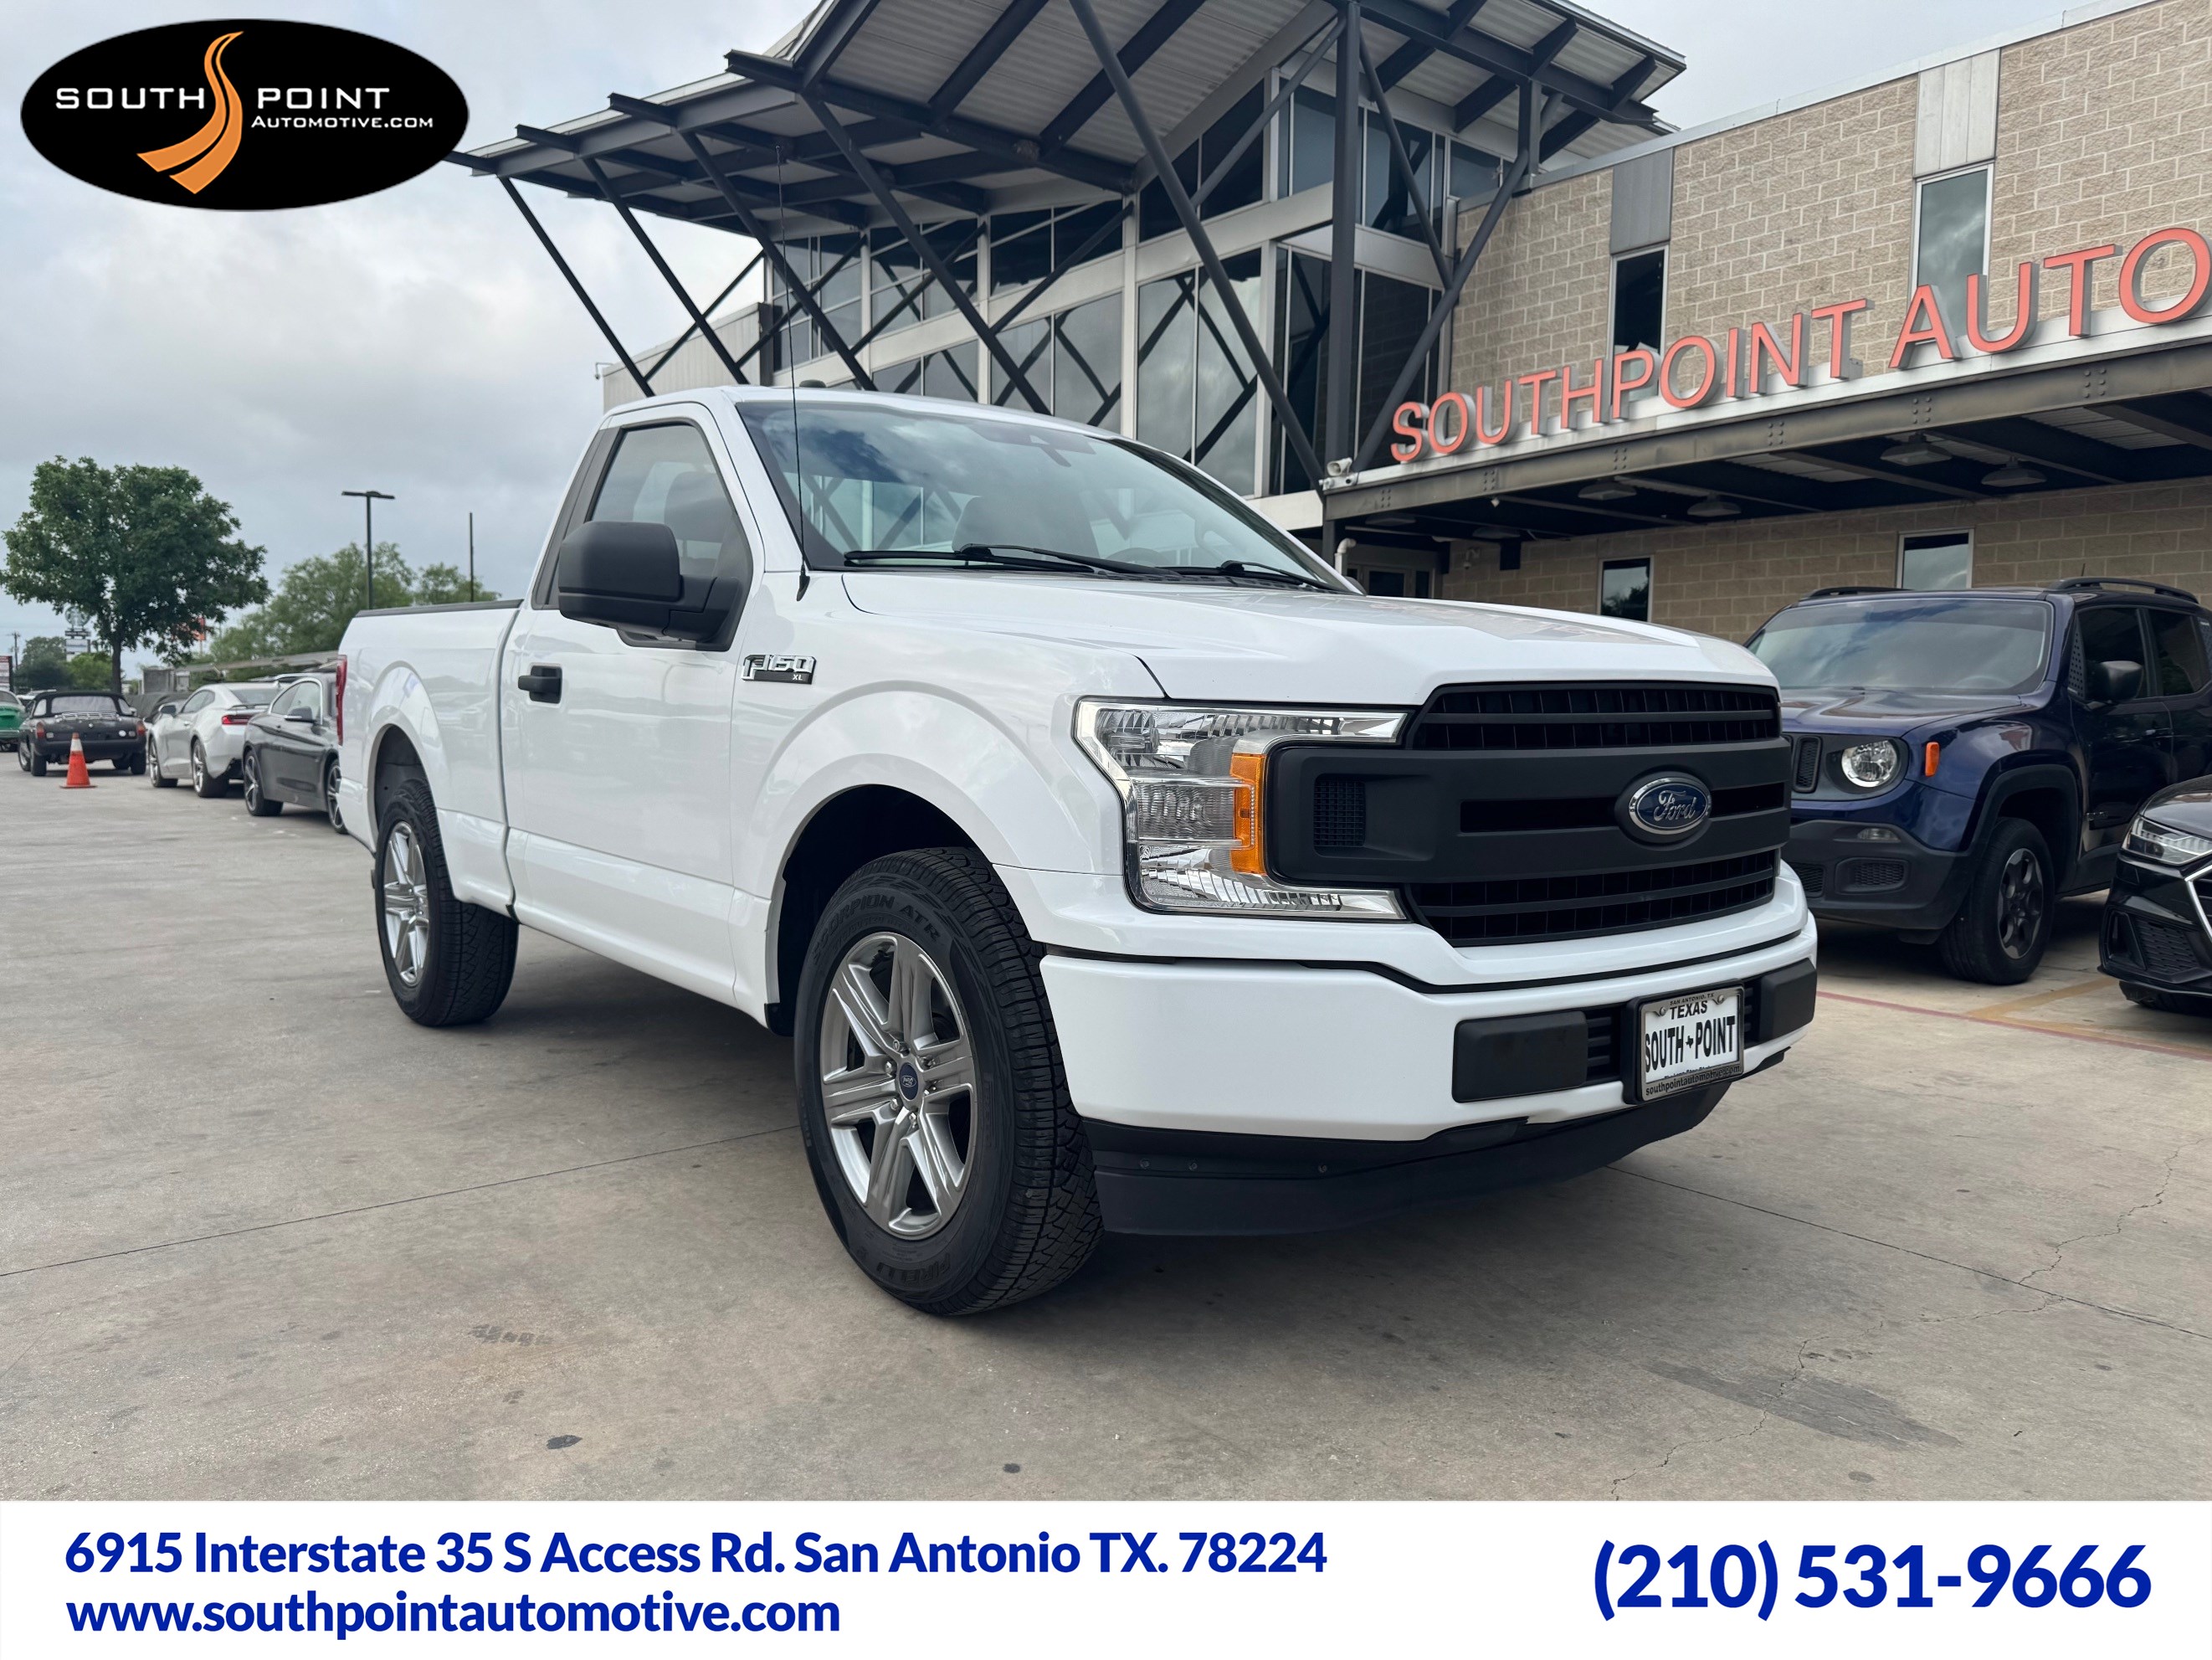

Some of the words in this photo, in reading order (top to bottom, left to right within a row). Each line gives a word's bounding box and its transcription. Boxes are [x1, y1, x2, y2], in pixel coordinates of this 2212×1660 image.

[1391, 297, 1871, 462] SOUTHPOINT
[1889, 228, 2212, 370] AUTO
[1653, 789, 1697, 822] Ford
[1670, 1000, 1708, 1020] TEXAS
[1645, 1025, 1685, 1073] SOUTH
[1695, 1015, 1736, 1059] POINT
[1645, 1065, 1741, 1096] southpointautomotive.com
